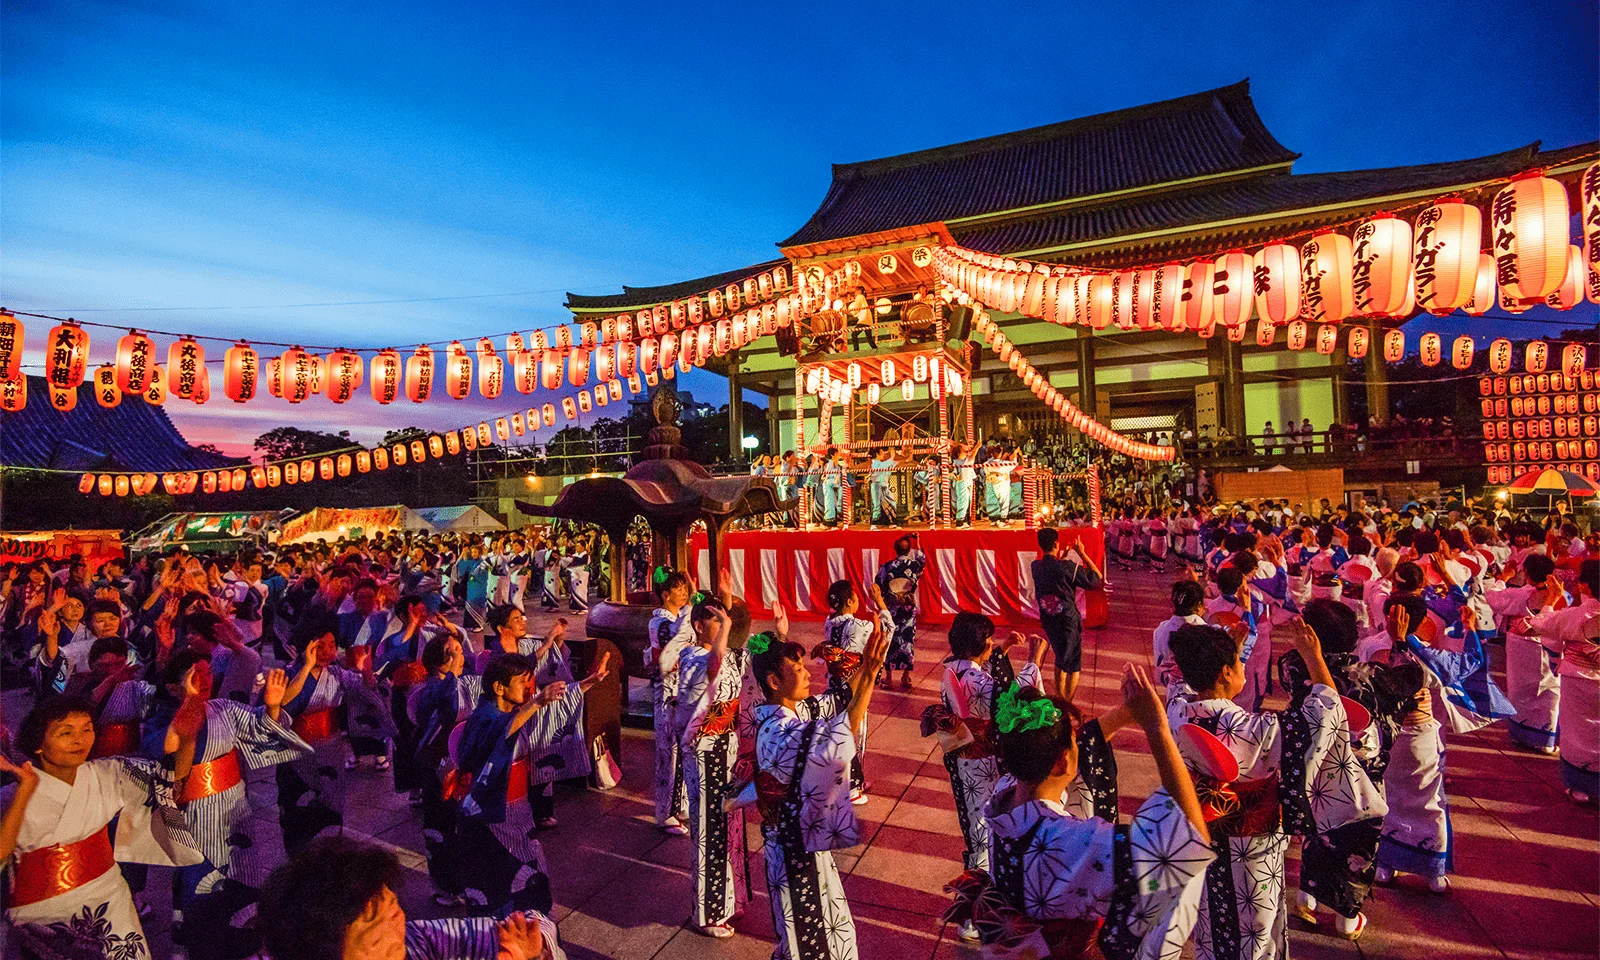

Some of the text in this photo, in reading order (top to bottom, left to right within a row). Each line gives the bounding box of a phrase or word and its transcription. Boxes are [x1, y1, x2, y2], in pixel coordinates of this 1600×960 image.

[1493, 189, 1520, 286] 寿々屋
[51, 329, 75, 384] 大利根
